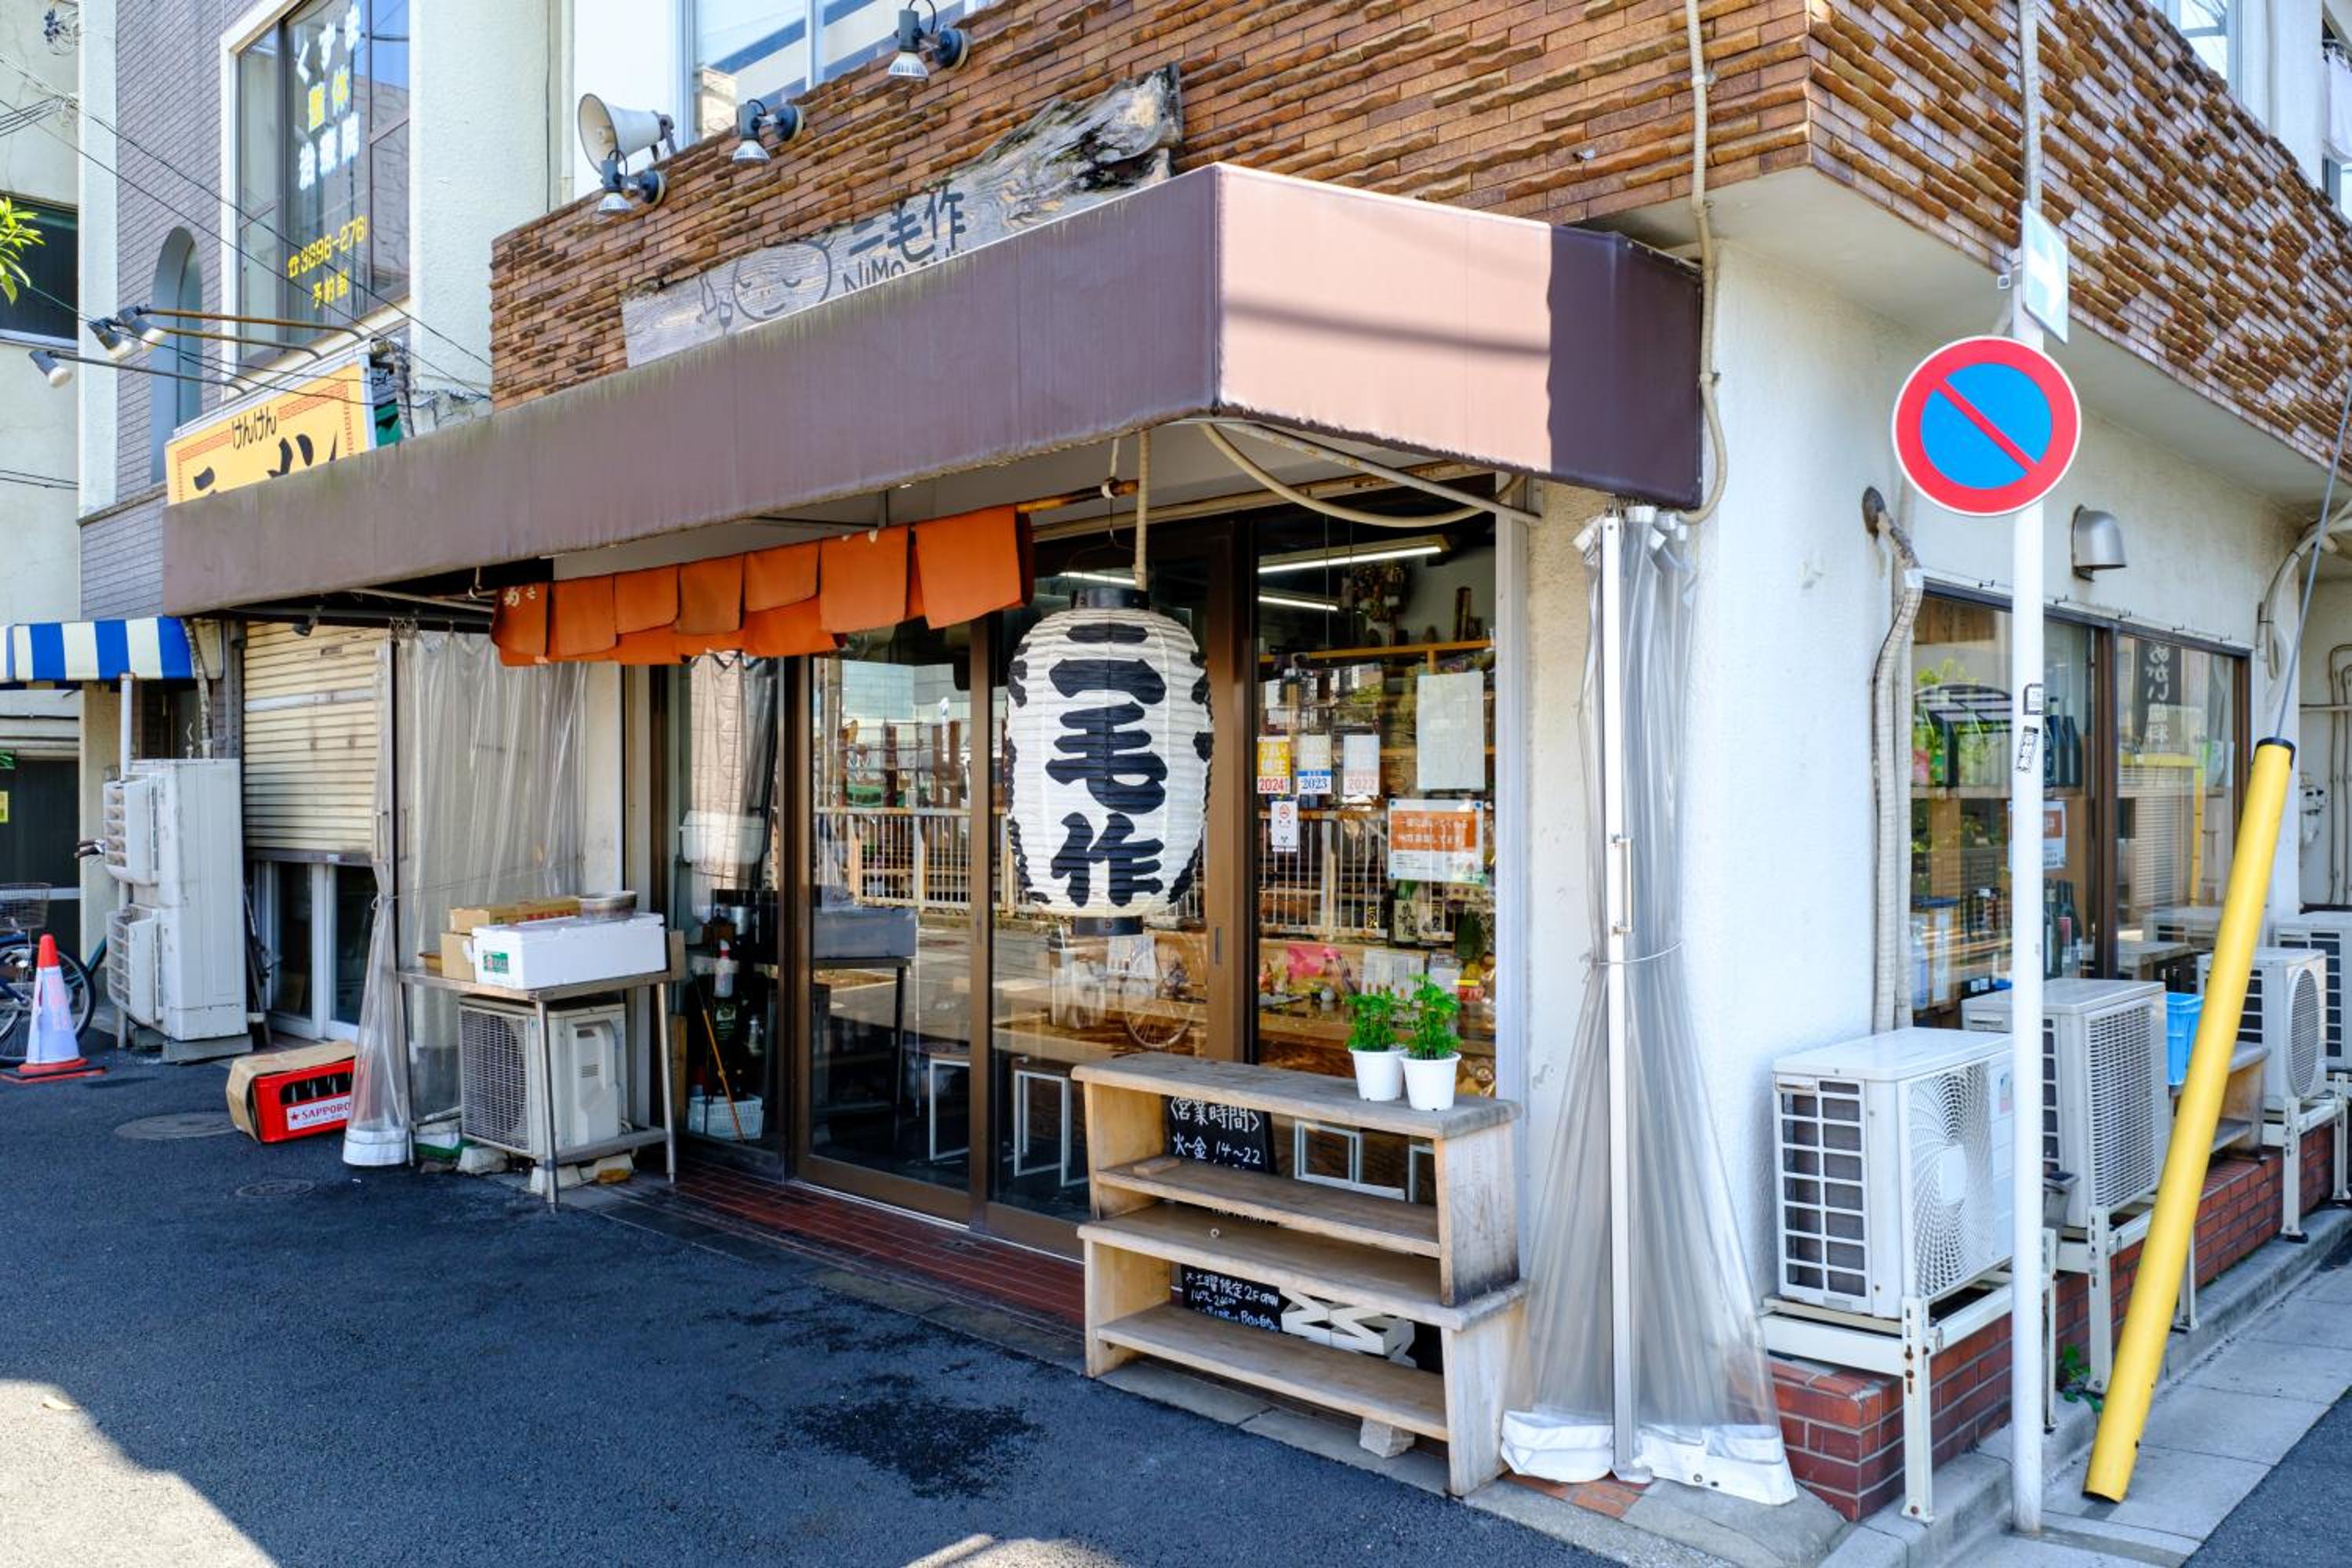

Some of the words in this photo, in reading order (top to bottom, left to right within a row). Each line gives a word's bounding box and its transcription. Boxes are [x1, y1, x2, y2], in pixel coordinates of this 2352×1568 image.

[848, 185, 967, 262] 二毛作
[231, 405, 277, 450] けんけん
[1045, 623, 1167, 908] 二毛作
[1259, 778, 1284, 791] 2024
[1301, 777, 1327, 789] 2023
[302, 1102, 351, 1120] SAPPORO
